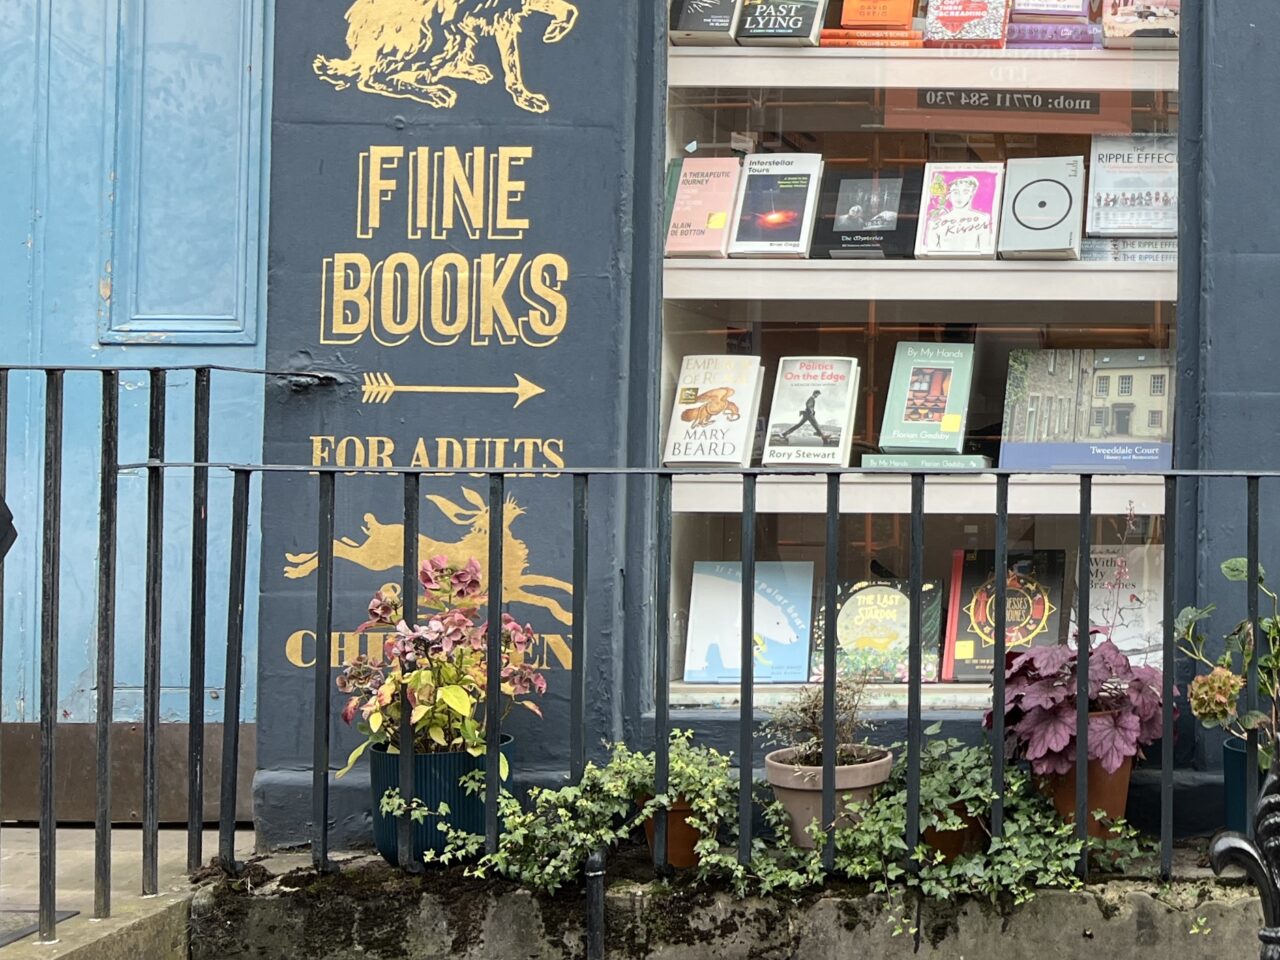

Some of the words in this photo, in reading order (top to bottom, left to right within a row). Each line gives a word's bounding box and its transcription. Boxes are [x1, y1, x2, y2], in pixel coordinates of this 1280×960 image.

[755, 4, 800, 17] PAST
[744, 16, 803, 29] LYING
[1098, 153, 1133, 164] RIPPLE
[1137, 153, 1176, 164] EFFEC
[689, 171, 731, 179] THERAPEUTIC
[357, 146, 533, 240] FINE
[1122, 240, 1136, 249] THE
[1138, 240, 1159, 249] RIPPLE
[1123, 254, 1137, 262] THE
[1138, 254, 1159, 262] RIPPLE
[320, 252, 568, 347] BOOKS
[907, 347, 918, 357] By
[920, 348, 934, 358] My
[937, 348, 963, 358] Hands
[799, 362, 834, 371] Politics
[784, 372, 801, 381] On
[802, 372, 819, 381] the
[820, 373, 846, 382] Edge
[684, 428, 730, 441] MARY
[892, 430, 918, 438] Florian
[671, 442, 736, 457] BEARD
[769, 449, 793, 460] Rory
[795, 449, 836, 460] Stewart
[1089, 446, 1133, 455] Tweeddale
[1135, 446, 1160, 454] Court
[309, 436, 399, 477] FOR
[410, 437, 567, 478] ADULTS
[1090, 569, 1106, 581] My
[856, 595, 875, 606] THE
[877, 594, 901, 608] LAST
[787, 605, 806, 629] bear
[854, 605, 898, 625] STARDOG
[285, 630, 573, 671] CHIEN
